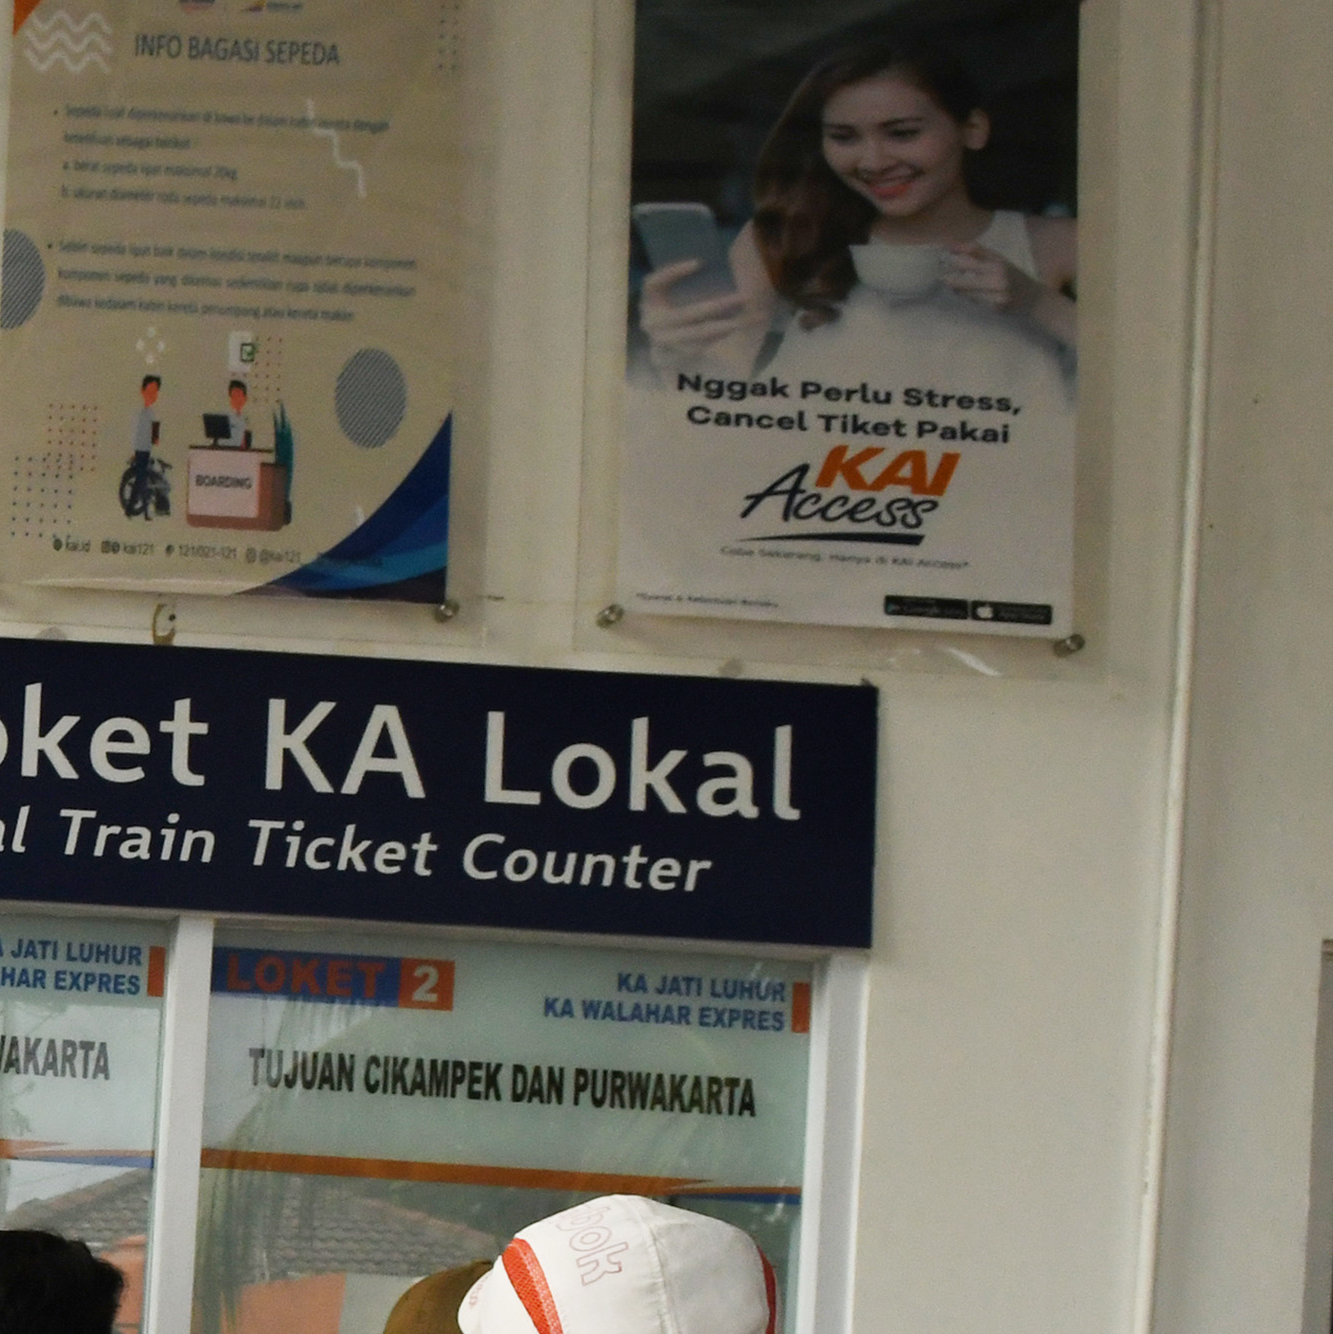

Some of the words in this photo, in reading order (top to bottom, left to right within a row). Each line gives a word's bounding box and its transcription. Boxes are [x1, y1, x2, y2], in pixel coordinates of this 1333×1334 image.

[134, 34, 183, 60] INFO
[188, 36, 260, 64] BAGASI
[265, 39, 341, 67] SEPEDA
[676, 373, 790, 402] Nggak
[800, 380, 893, 406] Perlu
[903, 387, 1023, 416] Stress,
[686, 405, 807, 433] Cancel
[817, 413, 908, 438] Tiket
[917, 419, 1010, 445] Pakai
[195, 474, 252, 490] BOARDING
[815, 445, 961, 497] KAI
[740, 463, 940, 529] Access
[264, 697, 426, 800] KA
[484, 710, 802, 822] Lokal
[59, 806, 216, 863] Train
[247, 818, 438, 879] Ticket
[462, 832, 713, 893] Counter
[10, 938, 59, 962] JATI
[66, 942, 143, 967] LUHUR
[53, 970, 141, 996] EXPRES
[226, 953, 386, 999] LOKET
[412, 966, 439, 1003] 2
[617, 973, 650, 995] KA
[656, 974, 704, 998] JATI
[710, 977, 786, 1003] LUHUR
[543, 997, 576, 1019] KA
[582, 998, 692, 1027] WALAHAR
[698, 1006, 785, 1032] EXPRES
[249, 1048, 356, 1095] TUJUAN
[364, 1055, 503, 1103] CIKAMPEK
[510, 1064, 565, 1106] DAN
[573, 1068, 757, 1118] PURWAKARTA
